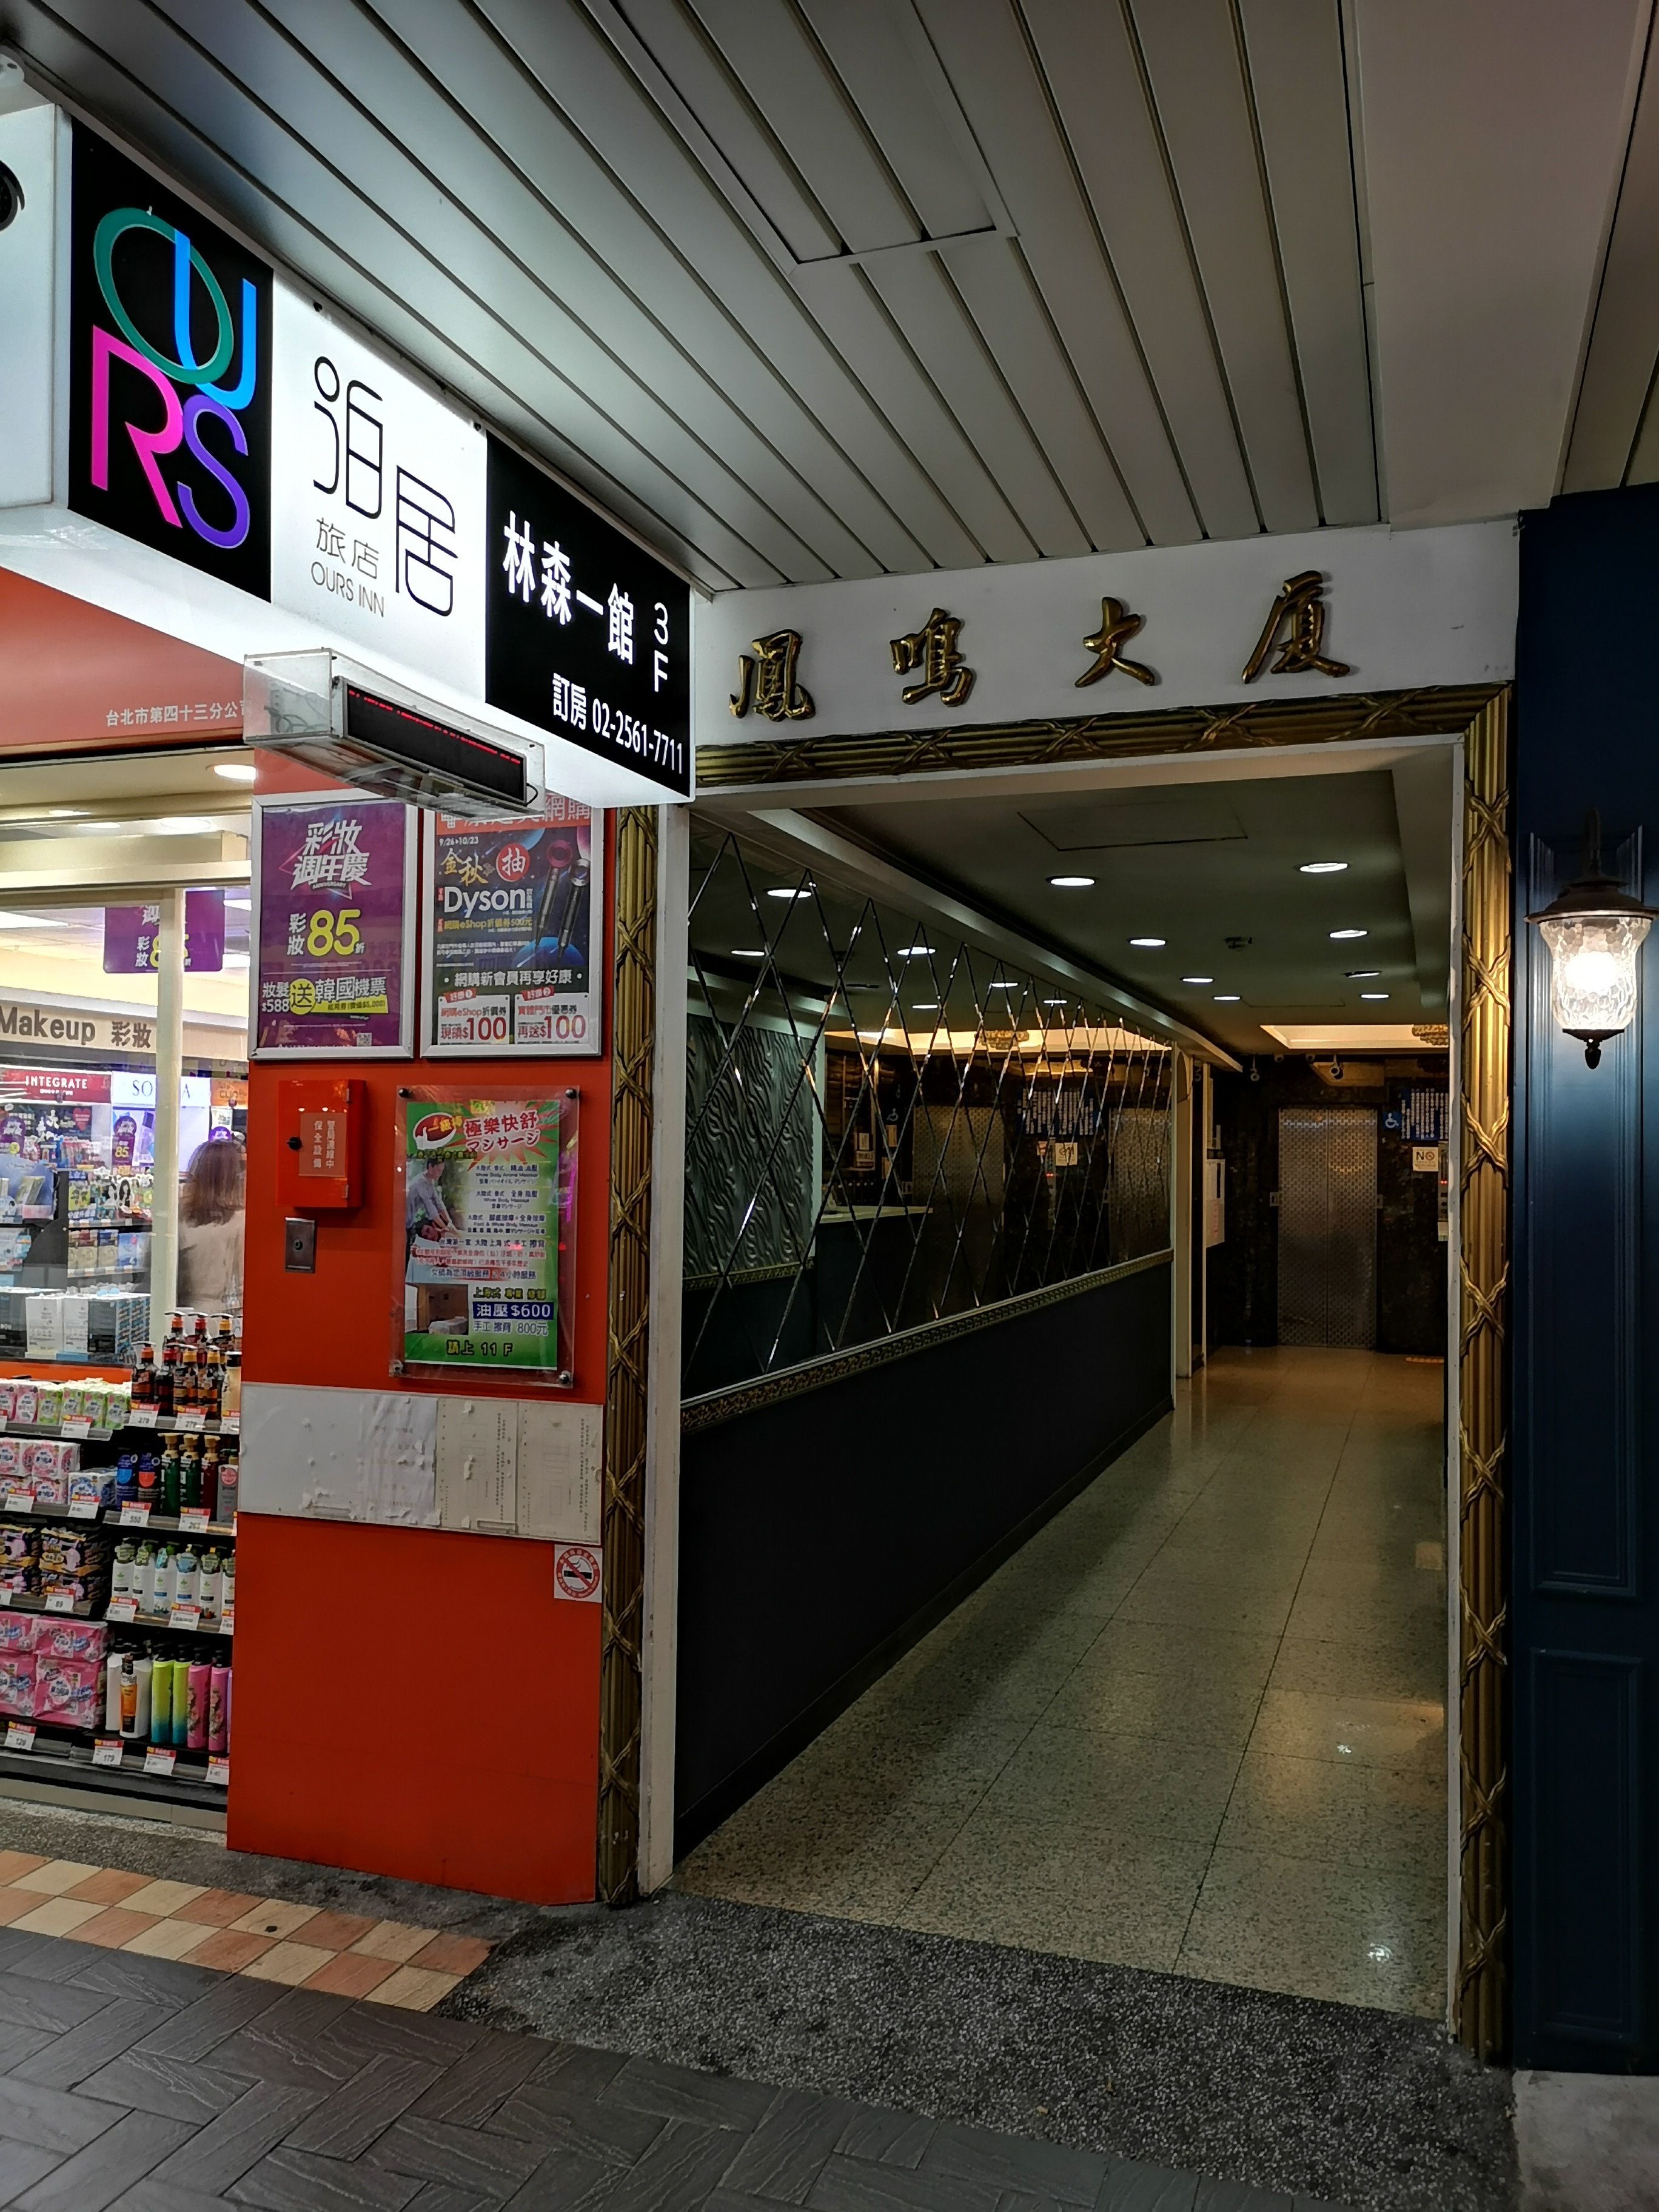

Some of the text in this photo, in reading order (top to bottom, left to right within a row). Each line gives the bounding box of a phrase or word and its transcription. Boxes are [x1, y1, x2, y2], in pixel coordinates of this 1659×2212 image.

[316, 517, 380, 580] 旅店
[310, 561, 384, 618] OURS INN
[502, 511, 635, 665] 林森一館
[107, 700, 244, 726] 台北市第四十三分公
[553, 673, 586, 730] 訂房
[592, 699, 683, 774] 02-2561-7711
[303, 820, 362, 856] 彩妝
[290, 853, 372, 890] 週年慶
[502, 848, 526, 876] 抽
[444, 886, 525, 918] Dyson
[287, 913, 306, 956] 彩妝
[262, 999, 289, 1013] $588
[291, 983, 313, 1007] 送
[315, 976, 386, 1002] 韓國機票
[0, 1006, 152, 1048] Makeup 彩妝
[25, 1075, 87, 1089] INTEGRATE
